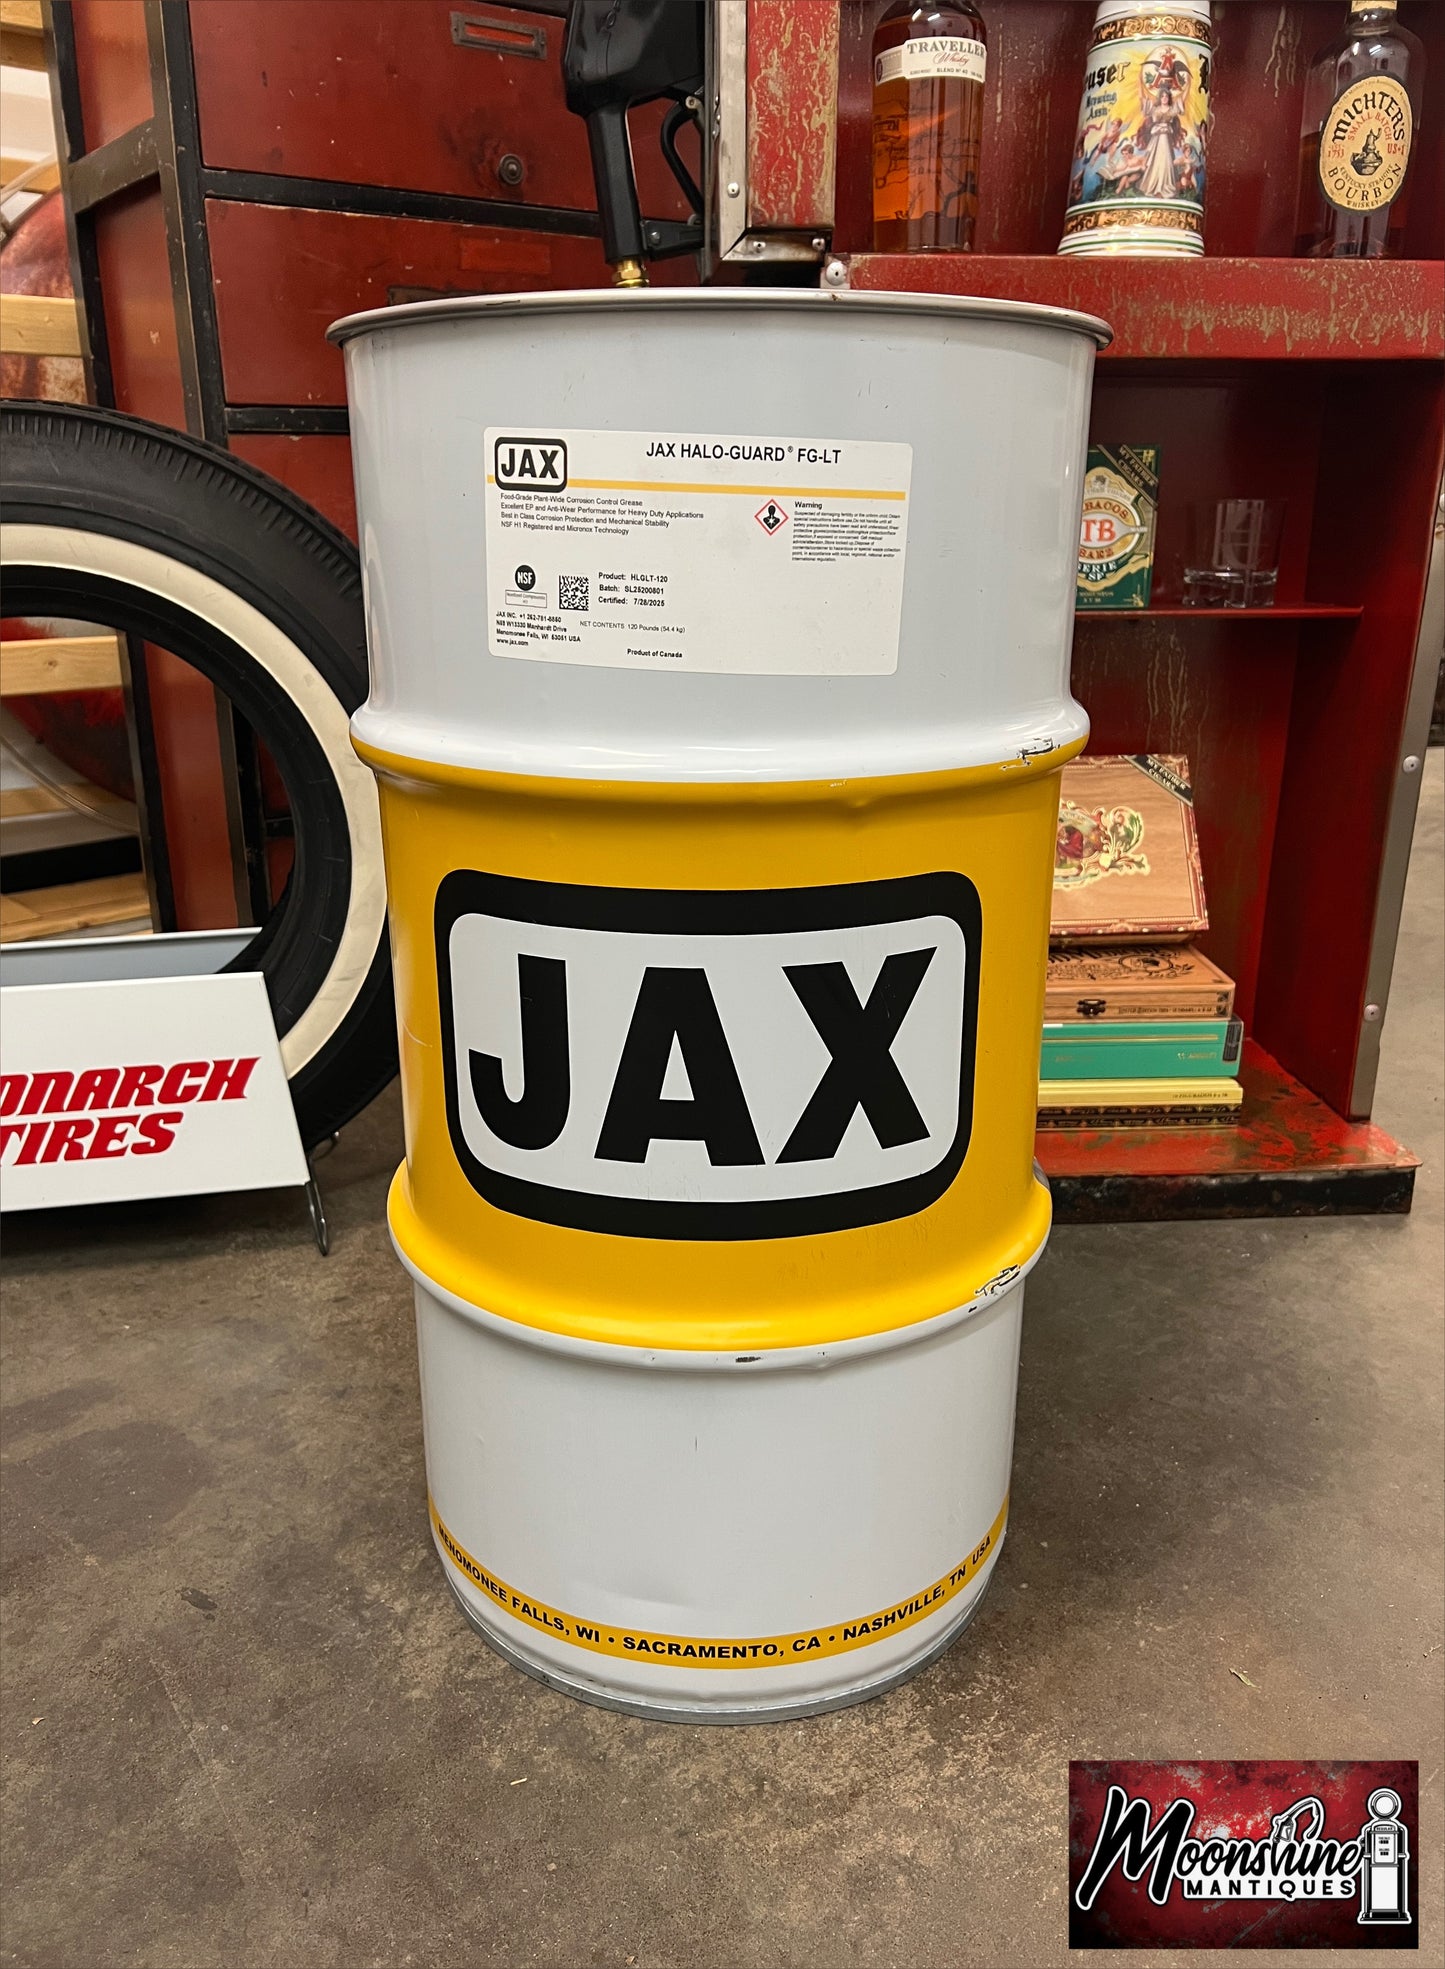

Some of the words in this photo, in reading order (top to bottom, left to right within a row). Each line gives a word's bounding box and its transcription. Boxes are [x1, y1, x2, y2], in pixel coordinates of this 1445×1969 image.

[907, 40, 985, 58] TRAVELLER
[1087, 61, 1131, 91] user
[1331, 91, 1405, 144] MICHTER'S
[1347, 111, 1374, 141] SMALL
[1374, 111, 1392, 140] BATCH
[1328, 163, 1402, 201] BOURBON
[1340, 166, 1366, 189] KENTUCKY
[1346, 199, 1379, 208] WHISKEY
[646, 442, 676, 458] JAX
[797, 448, 842, 464] FG-LT
[500, 448, 559, 479] JAX
[500, 493, 532, 501] Food-Grade
[534, 495, 565, 503] Plant-Wide
[794, 501, 823, 510] Warning
[500, 502, 524, 510] Excellent
[577, 507, 616, 515] Performance
[628, 509, 648, 517] Heavy
[649, 510, 664, 518] Duty
[665, 511, 704, 519] Applications
[1083, 501, 1129, 520] BACOS
[523, 522, 553, 531] Registered
[594, 526, 630, 535] Technology
[565, 515, 594, 523] Protection
[608, 518, 643, 526] Mechanical
[644, 519, 670, 528] Stability
[1082, 518, 1117, 542] TB
[517, 571, 534, 585] NSF
[598, 572, 627, 581] Product:
[630, 573, 669, 583] HLGLT-120
[599, 583, 621, 593] Batch:
[598, 596, 628, 605] Certified:
[496, 611, 506, 619] JAX
[552, 625, 567, 633] Drive
[592, 622, 625, 630] CONTENTS
[639, 624, 660, 632] Pounds
[676, 626, 686, 634] kg)
[496, 638, 529, 647] www.jax.com
[627, 648, 651, 657] Product
[659, 650, 683, 658] Canada
[468, 945, 939, 1168] JAX
[0, 1111, 184, 1168] TIRES
[438, 1522, 508, 1603] MENOMONEE
[511, 1596, 571, 1636] FALLS,
[575, 1624, 601, 1643] WI
[623, 1636, 785, 1659] SACRAMENTO,
[792, 1636, 821, 1652] CA
[843, 1585, 945, 1641] NASHVILLE,
[949, 1565, 967, 1587] TN
[972, 1535, 992, 1565] USA
